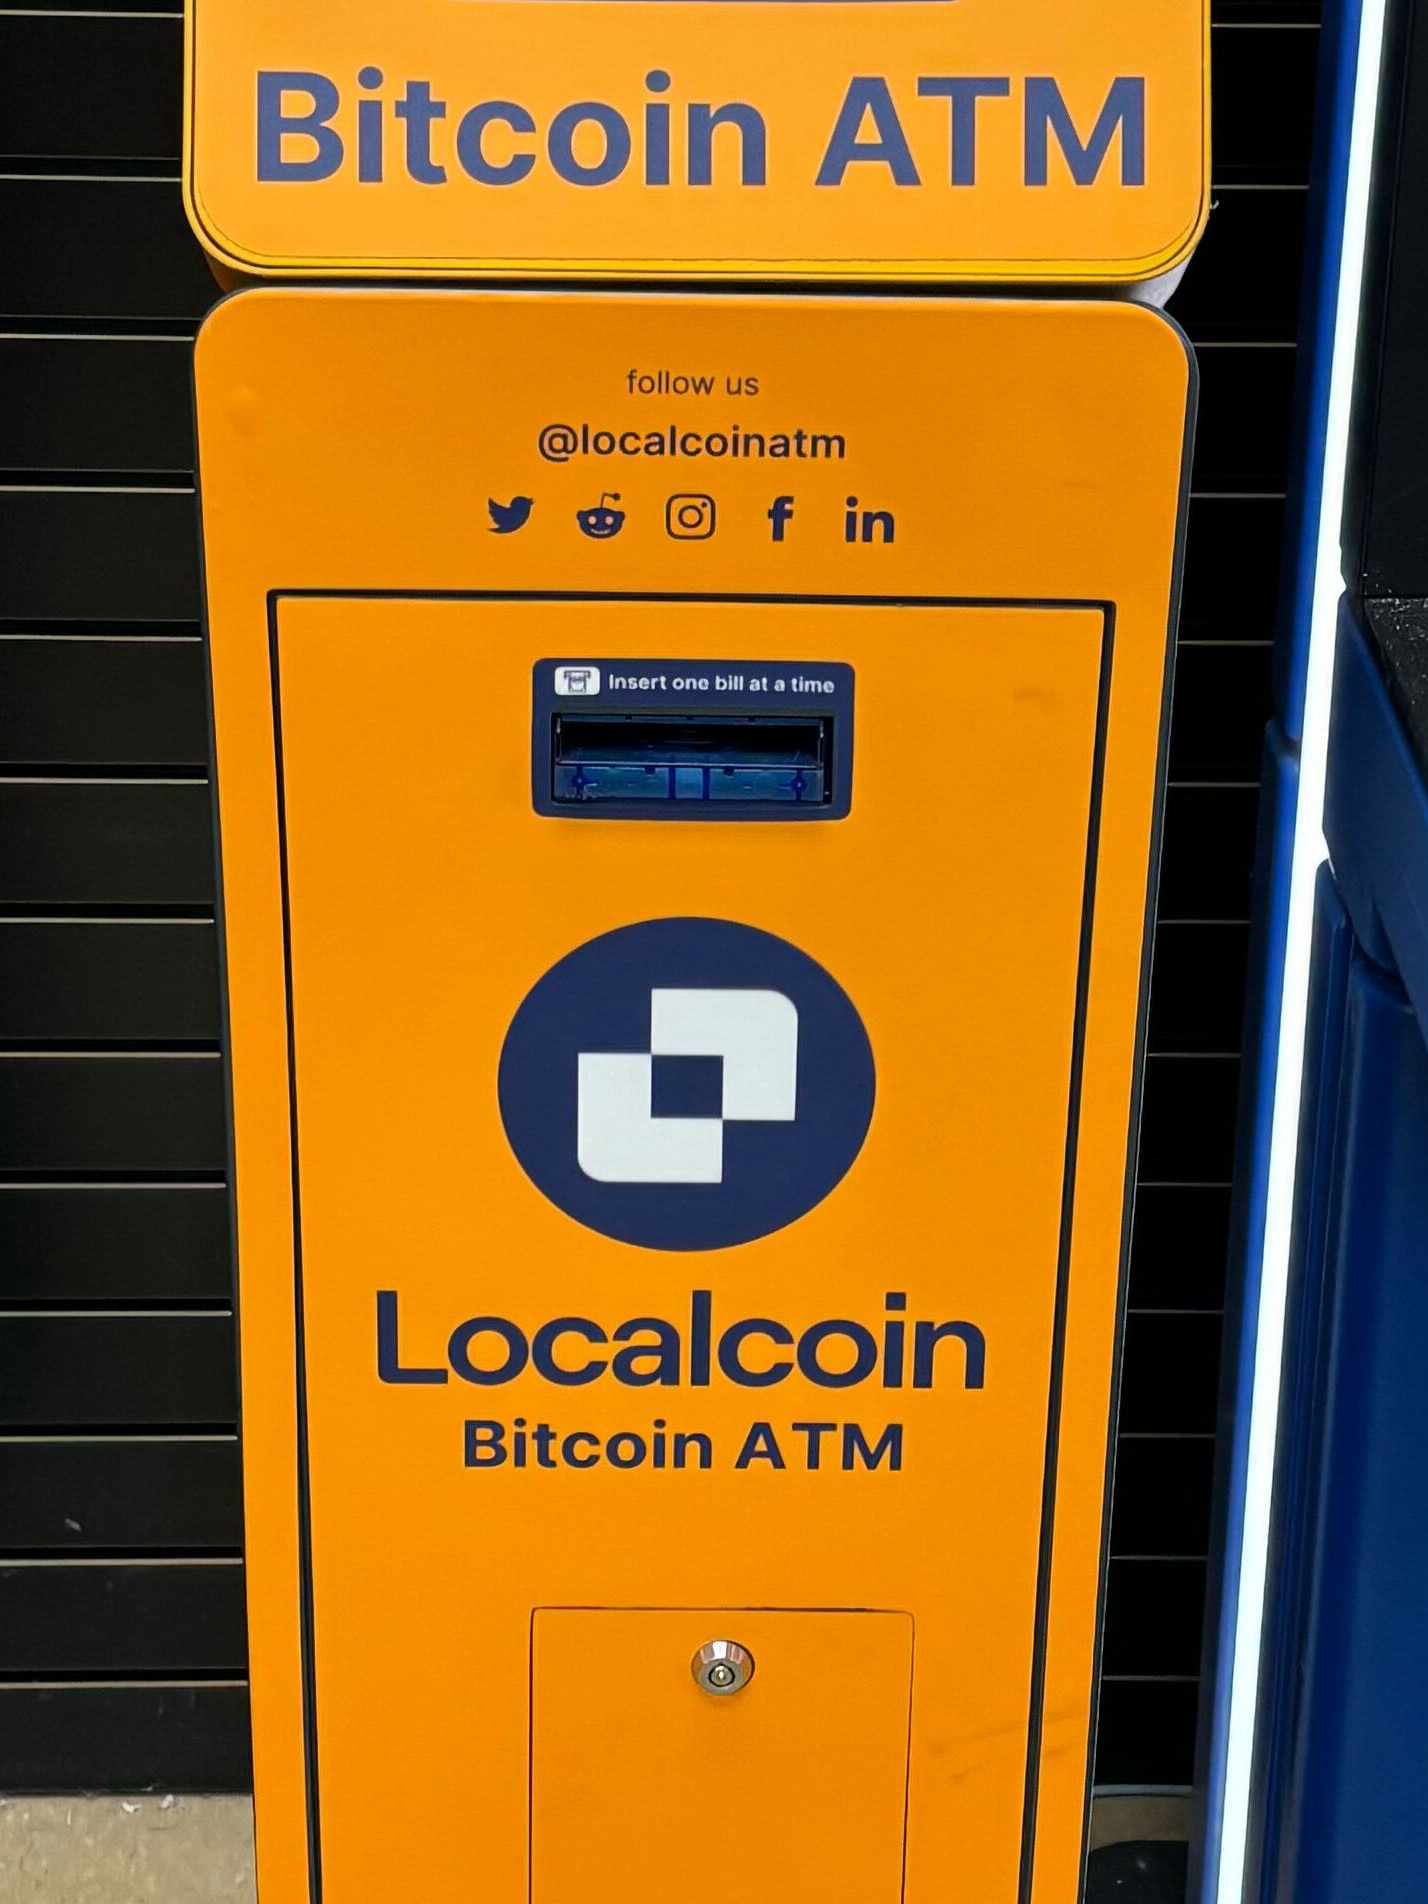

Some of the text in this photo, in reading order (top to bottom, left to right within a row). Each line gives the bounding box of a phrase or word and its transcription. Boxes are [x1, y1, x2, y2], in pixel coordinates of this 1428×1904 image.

[255, 66, 1147, 187] Bitcoin ATM
[626, 369, 761, 396] follow us
[537, 423, 847, 463] @localcoinatm
[844, 496, 896, 543] in
[608, 674, 835, 694] Insert one bill at a time
[376, 1290, 985, 1389] Localcoin
[464, 1418, 903, 1471] Bitcoin ATM
